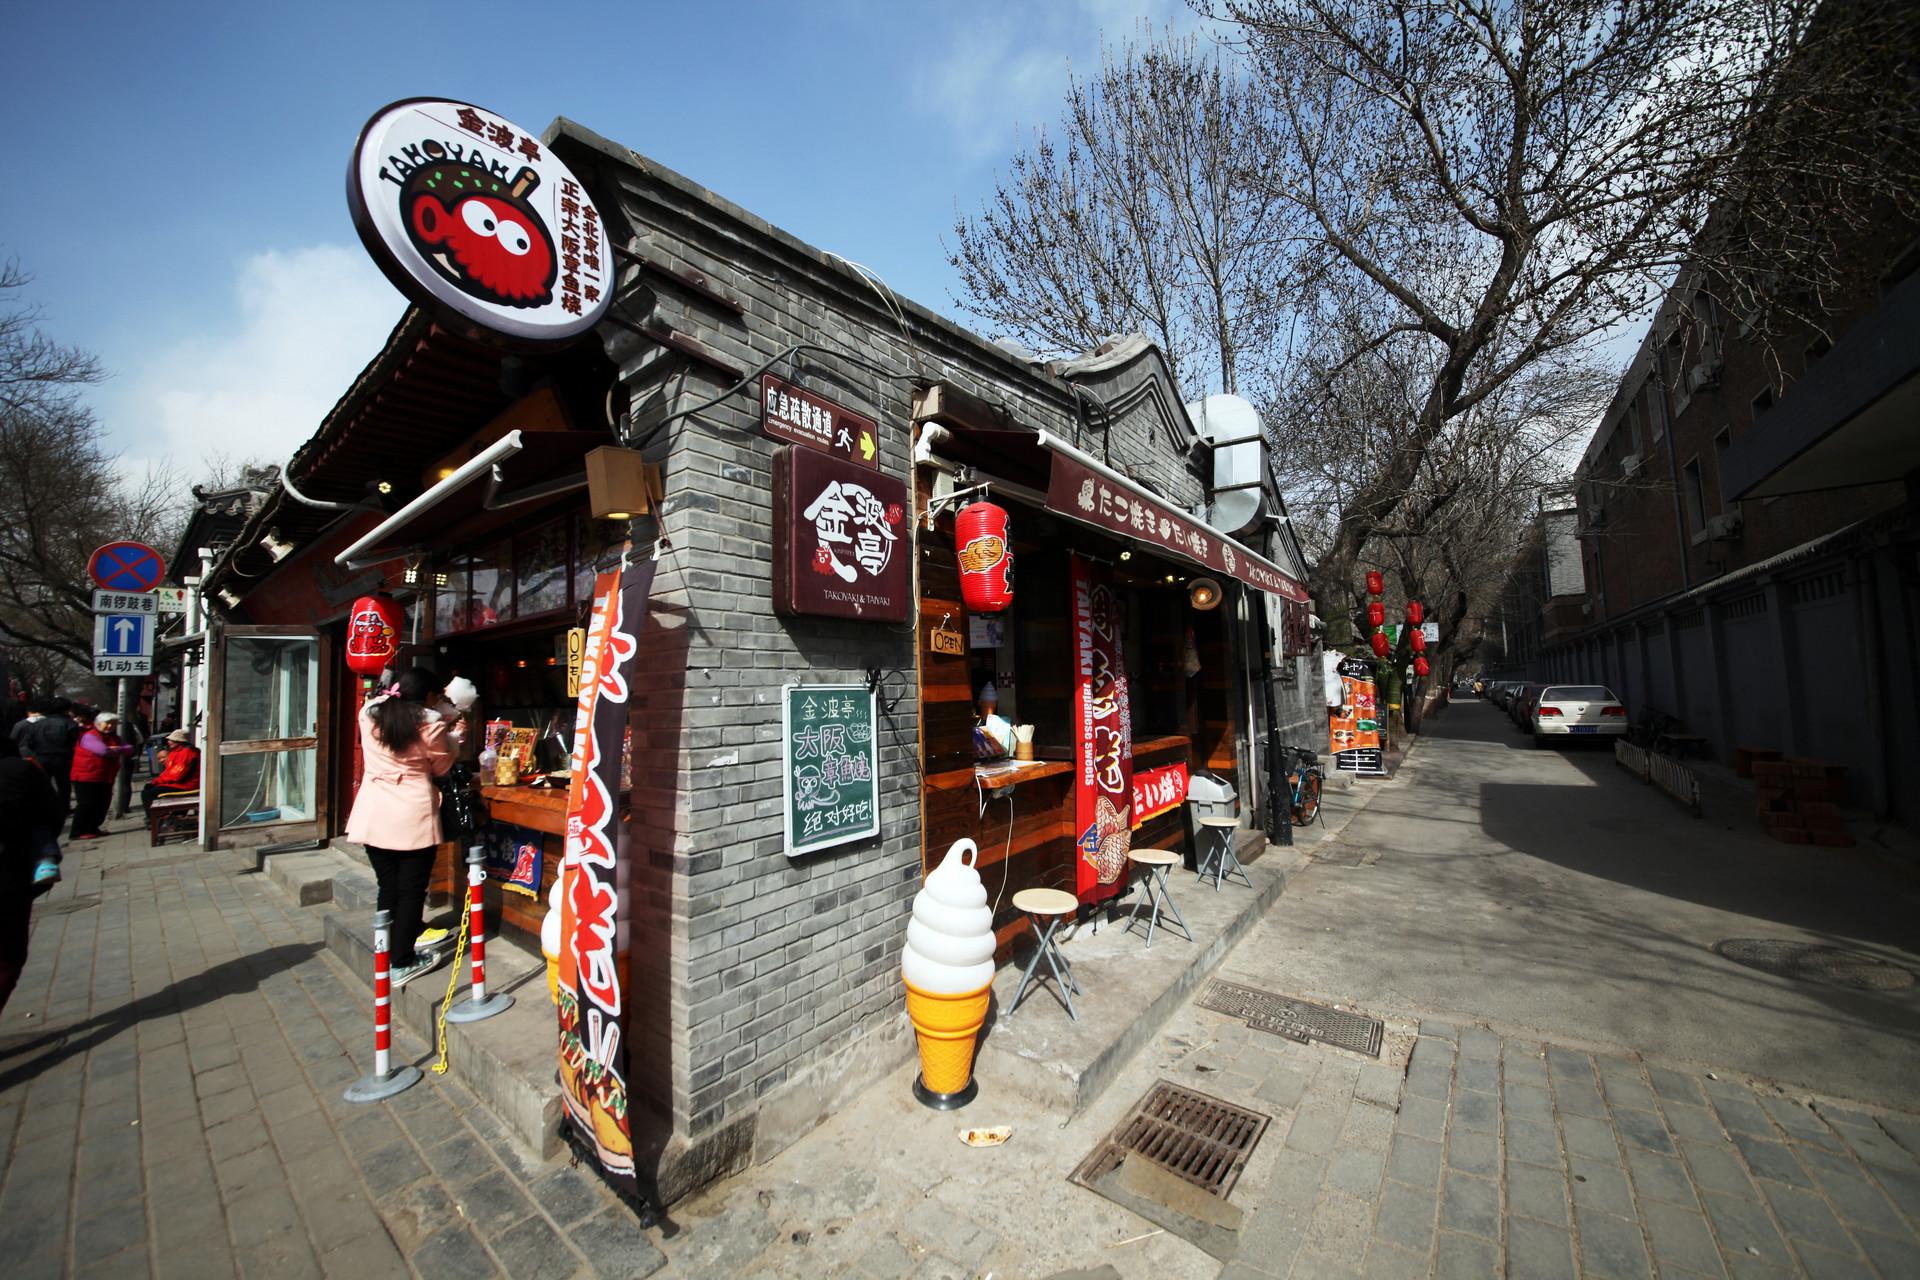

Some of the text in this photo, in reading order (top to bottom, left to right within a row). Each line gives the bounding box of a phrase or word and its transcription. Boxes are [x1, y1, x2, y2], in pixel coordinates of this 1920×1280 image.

[456, 108, 542, 163] 金波亭
[766, 386, 833, 439] 应急疏散通道
[767, 417, 792, 433] Emergency
[793, 427, 816, 442] evacuation
[803, 479, 899, 583] 金波亭
[1099, 484, 1156, 534] たこ焼き
[100, 594, 153, 611] 南锣鼓巷
[823, 588, 859, 603] TAKOYAKI
[934, 633, 963, 651] OPEN
[1075, 579, 1093, 676] TAIYAKI
[96, 660, 150, 673] 机动车
[569, 631, 581, 695] OPEN
[571, 591, 610, 772] TAKOYAKI
[801, 695, 856, 720] 金波亭
[793, 724, 847, 761] 大阪
[1083, 683, 1095, 786] Japanese sweets
